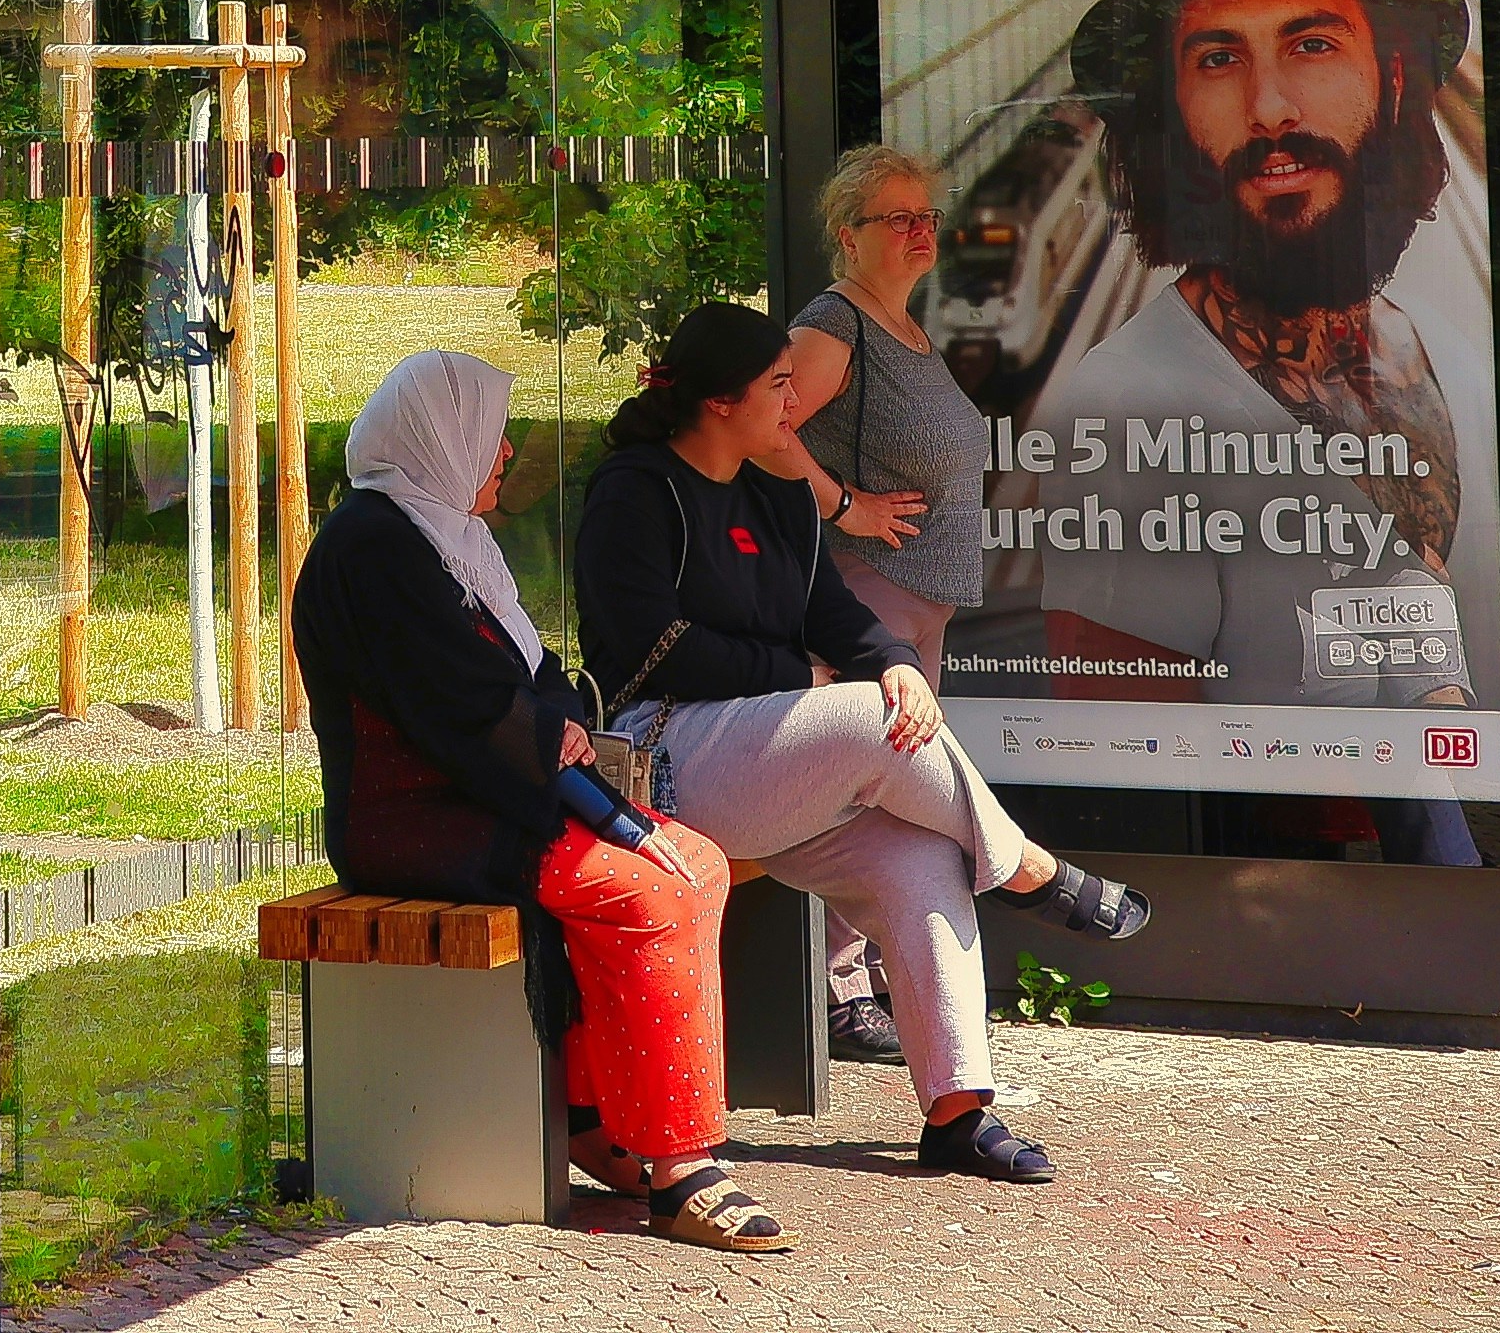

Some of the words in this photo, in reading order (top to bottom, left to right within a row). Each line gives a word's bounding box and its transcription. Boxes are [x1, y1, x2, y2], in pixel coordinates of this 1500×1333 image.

[983, 415, 1057, 473] lle
[1070, 417, 1108, 474] 5
[1125, 415, 1431, 478] Minuten.
[983, 493, 1124, 552] urch
[1139, 493, 1244, 553] die
[1259, 494, 1411, 570] City.
[1332, 604, 1344, 626] 1
[1347, 595, 1435, 625] Ticket
[940, 653, 1230, 679] -bahn-mitteldeutschland.de
[1331, 647, 1352, 660] Zug
[1423, 646, 1445, 657] BUS
[1312, 743, 1344, 758] VVO
[1430, 734, 1473, 762] DB
